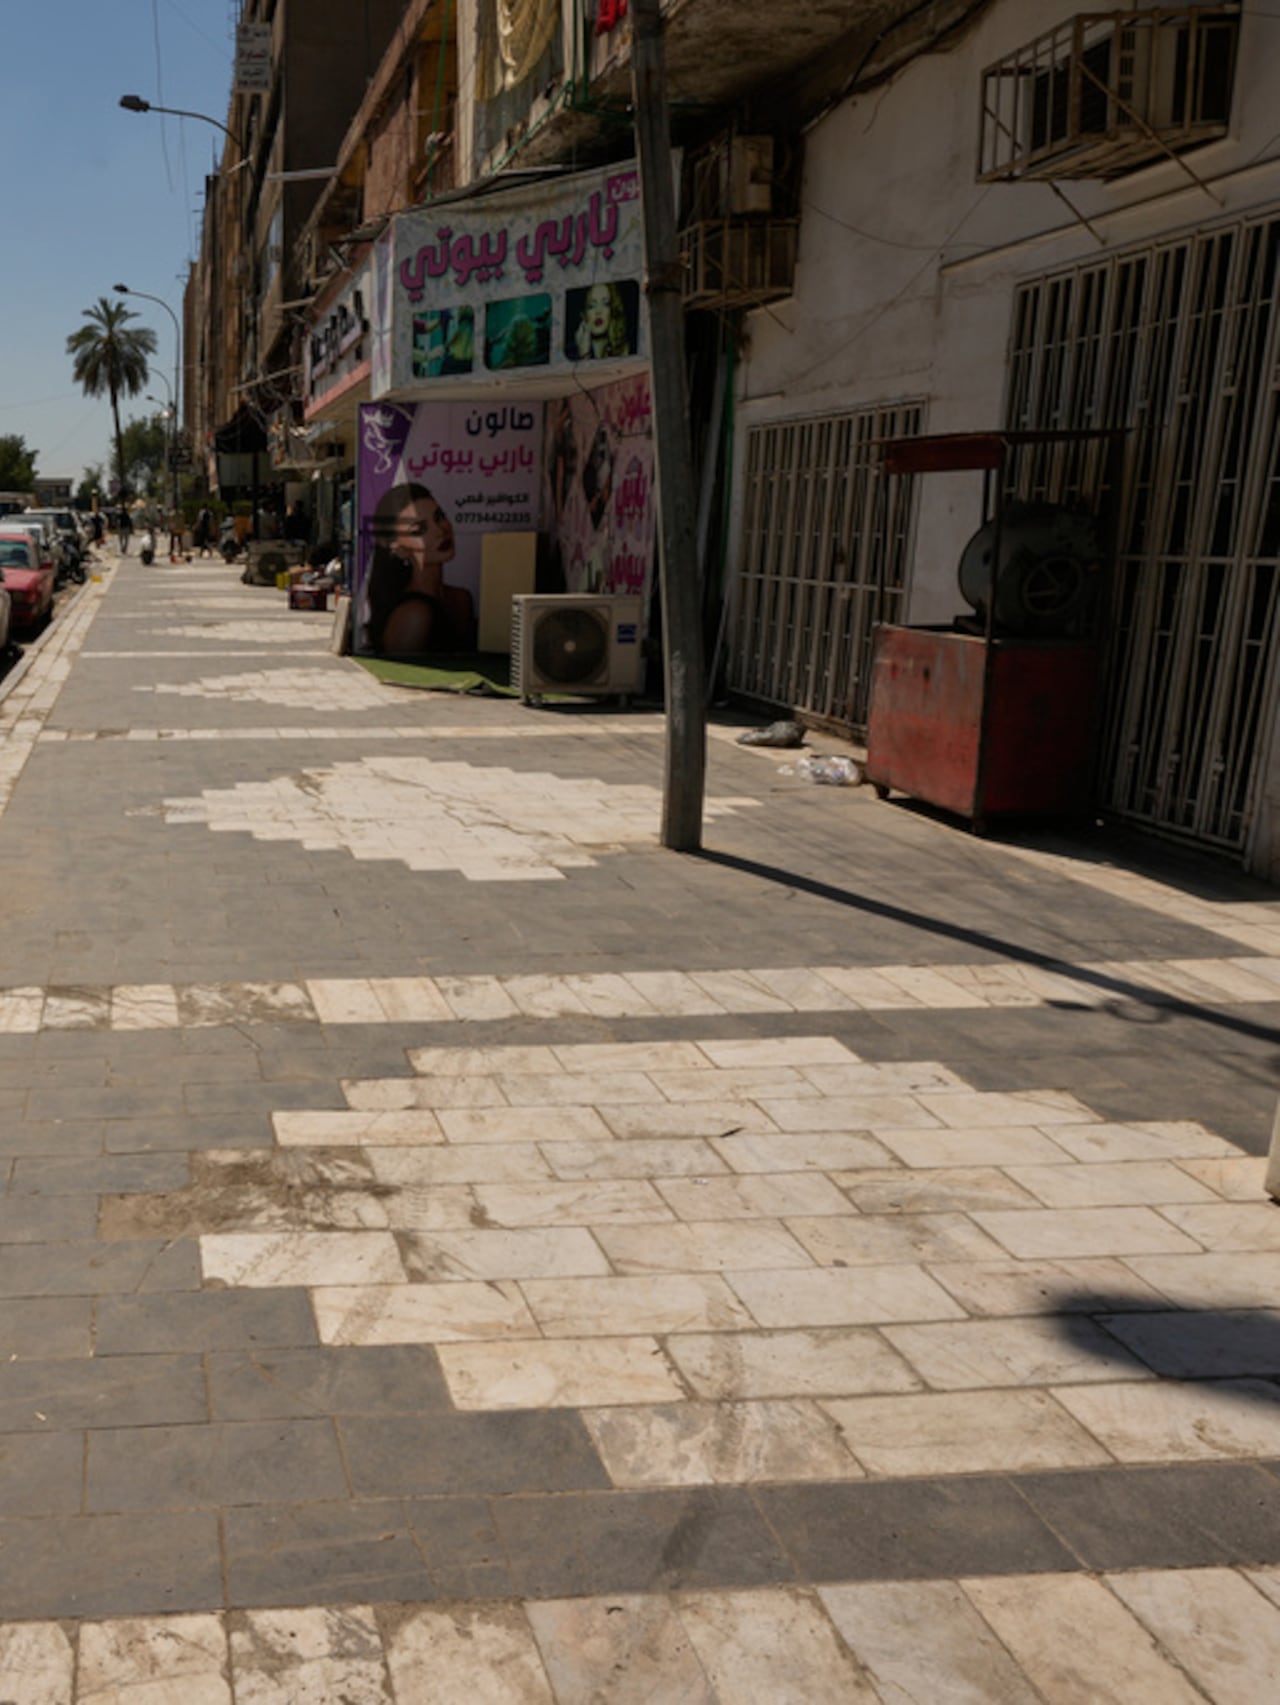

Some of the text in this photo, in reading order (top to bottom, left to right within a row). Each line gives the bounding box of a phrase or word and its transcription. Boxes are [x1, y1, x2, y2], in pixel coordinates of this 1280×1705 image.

[399, 190, 621, 302] باربي بيوتي
[466, 407, 534, 437] صالون
[407, 442, 534, 478] باربي بيوتي
